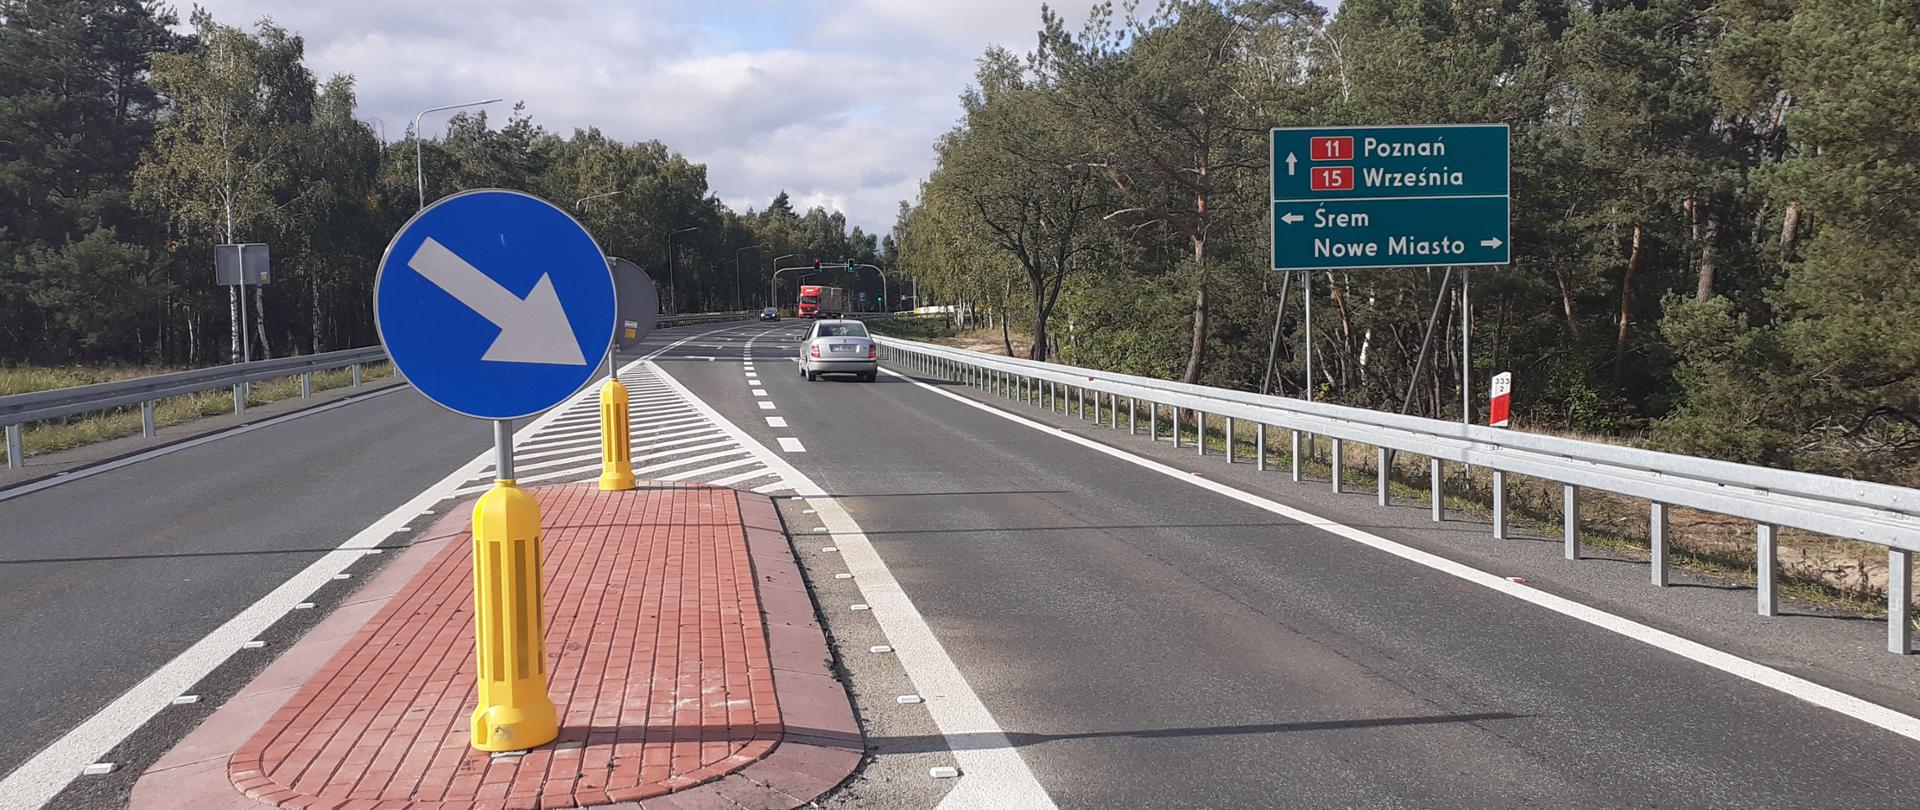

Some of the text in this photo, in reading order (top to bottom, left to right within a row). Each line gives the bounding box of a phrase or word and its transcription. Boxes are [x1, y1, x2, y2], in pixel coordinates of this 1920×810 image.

[1326, 136, 1445, 157] 11 Poznań
[1322, 166, 1464, 187] 15 Września
[1314, 203, 1369, 228] Śrem
[1314, 236, 1465, 258] Nowe Miasto
